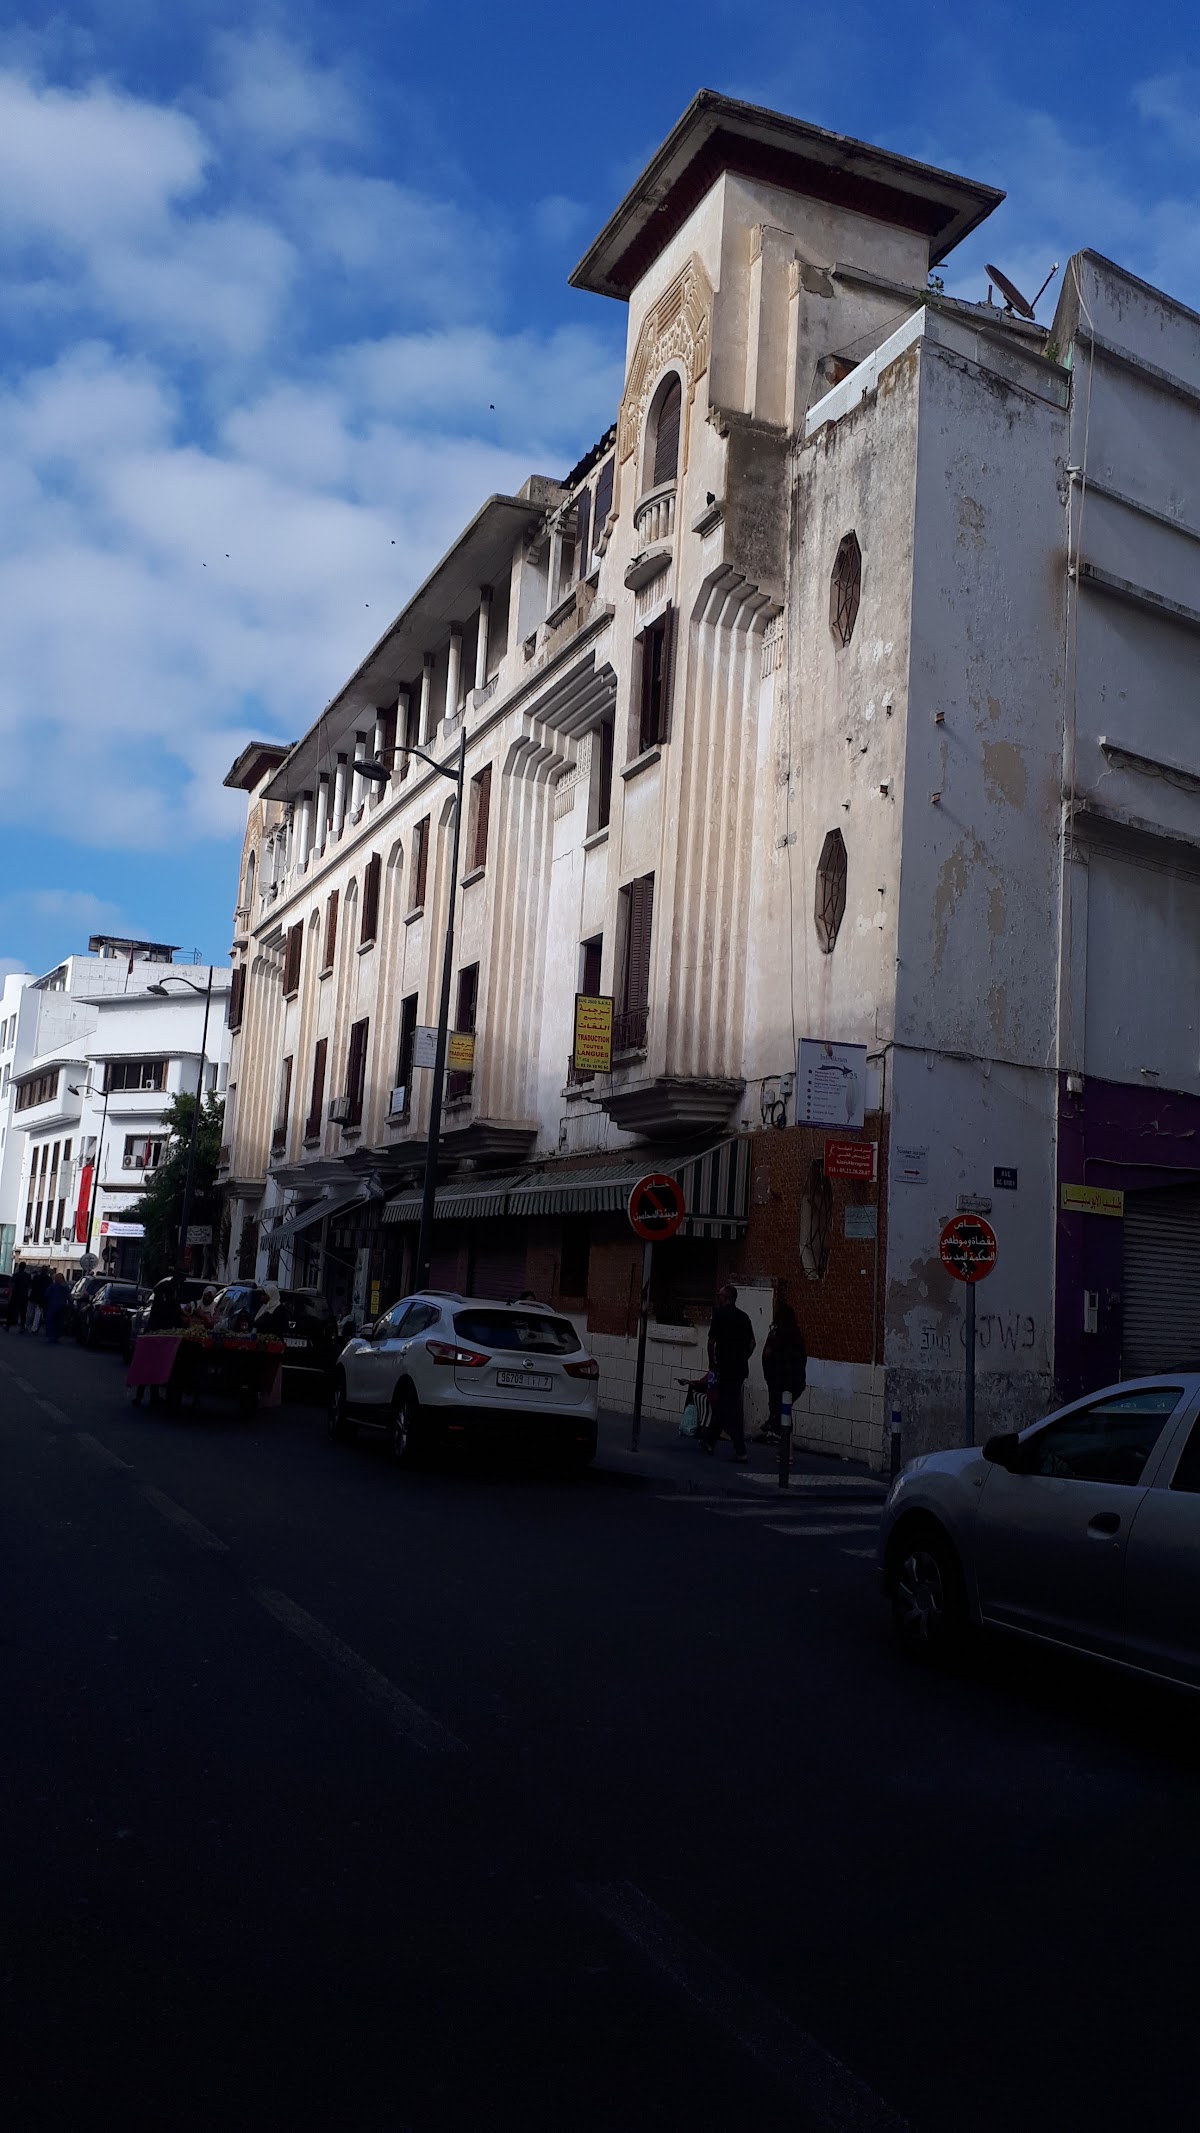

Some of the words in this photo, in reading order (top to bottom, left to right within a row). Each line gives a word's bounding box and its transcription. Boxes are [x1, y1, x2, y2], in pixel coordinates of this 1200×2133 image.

[579, 1004, 611, 1015] ترجمة
[577, 1022, 610, 1031] اللغات
[577, 1033, 610, 1044] TRADUCTION
[449, 1050, 474, 1058] TRADUCTION
[577, 1049, 609, 1058] LANGUES
[643, 1179, 670, 1191] خاص
[633, 1209, 659, 1222] المحامين
[954, 1219, 982, 1230] خاص
[941, 1250, 968, 1263] المدنية
[969, 1249, 996, 1262] المحكمة
[501, 1372, 524, 1384] 96709
